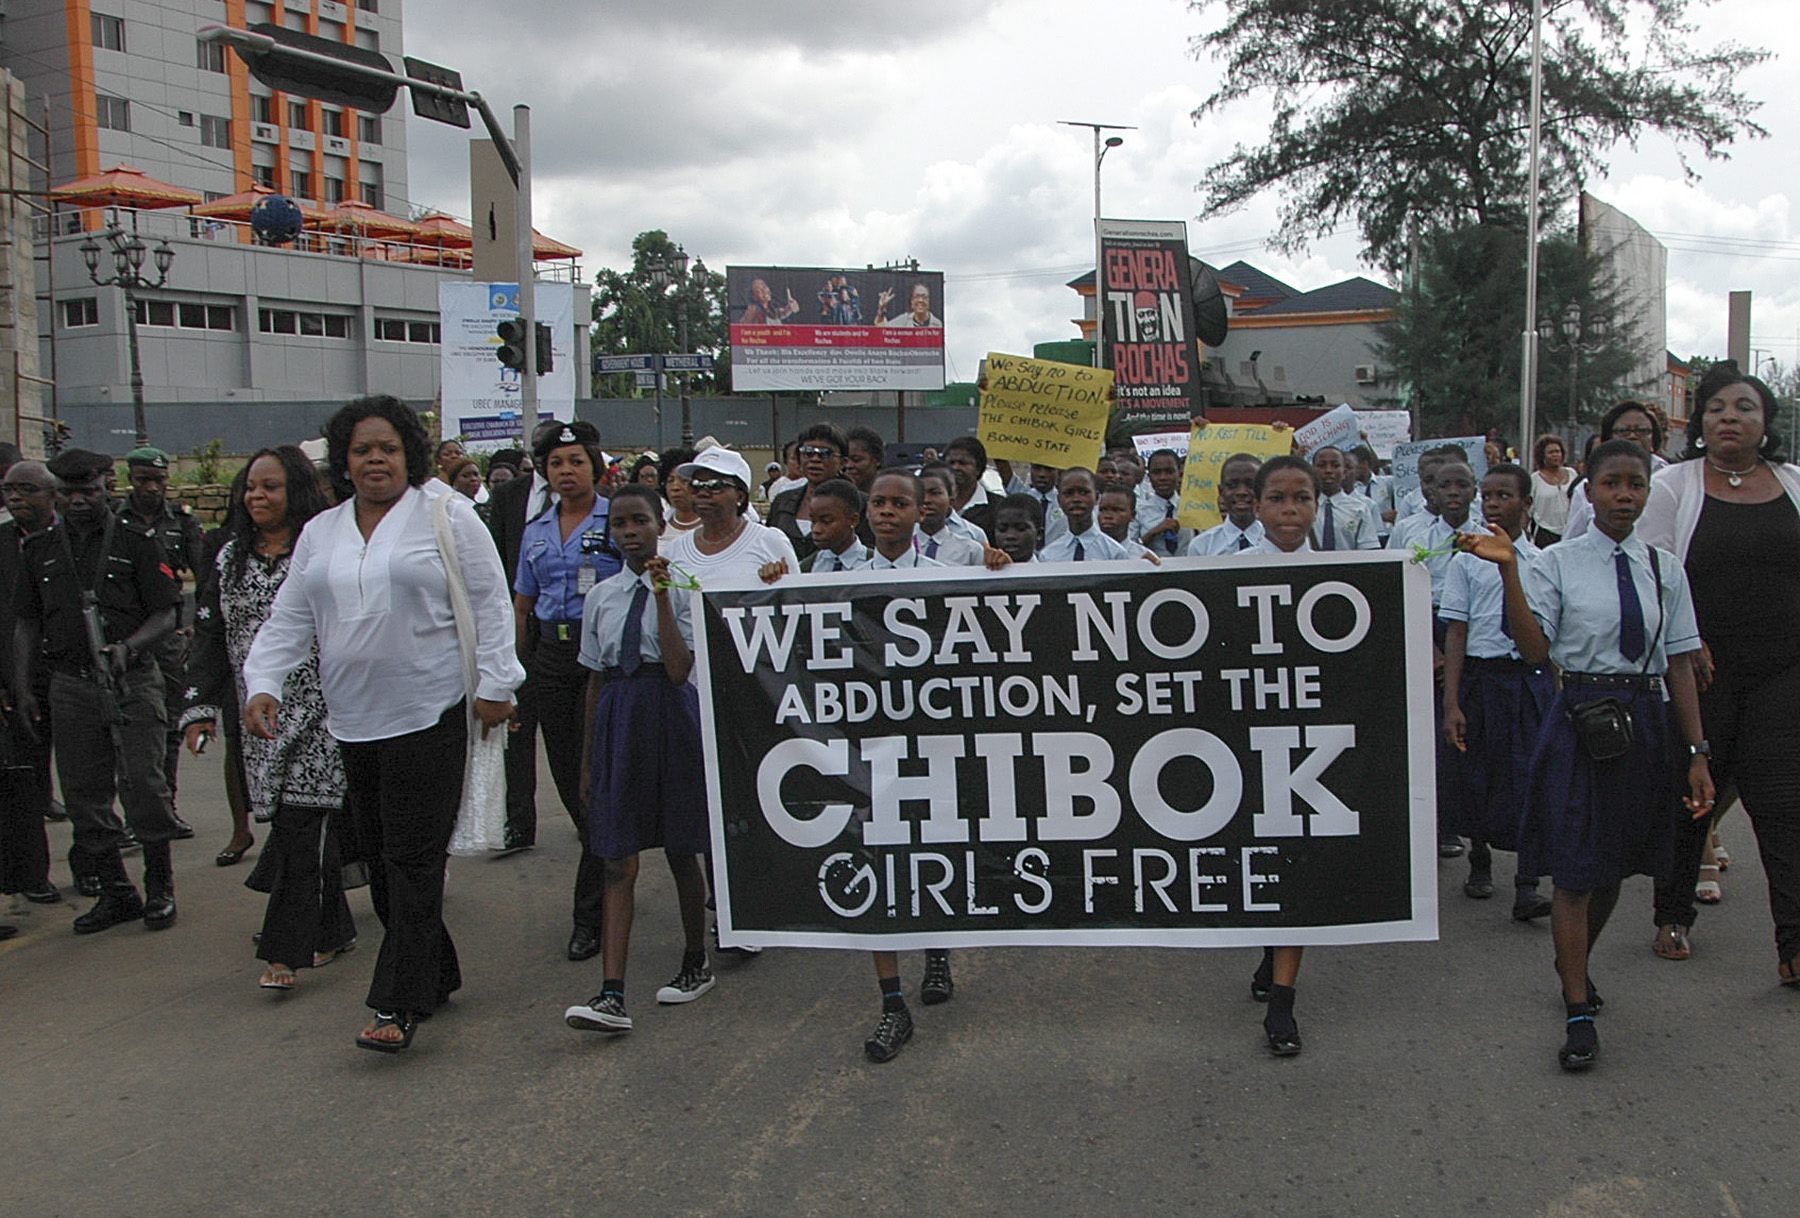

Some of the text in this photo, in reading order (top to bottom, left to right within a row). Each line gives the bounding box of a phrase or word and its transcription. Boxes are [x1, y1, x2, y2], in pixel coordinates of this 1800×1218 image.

[1106, 249, 1179, 290] GENERA
[991, 358, 1012, 371] We
[1046, 366, 1066, 378] no
[1075, 369, 1093, 381] to
[1114, 344, 1190, 384] ROCHAS
[866, 375, 888, 383] BACK
[1132, 386, 1148, 396] not
[1149, 387, 1161, 396] an
[1162, 385, 1182, 396] idea
[472, 399, 492, 409] UBEC
[1133, 399, 1141, 408] A
[1141, 398, 1190, 408] MOVEMENT
[982, 412, 1100, 440] THE CHIBOK GIRLS
[1034, 438, 1072, 453] STATE
[722, 581, 1372, 673] WE SAY NO TO
[774, 666, 1322, 724] ABDUCTION, SET THE
[756, 724, 1361, 849] CHIBOK
[818, 846, 1282, 918] GIRLS FREE
